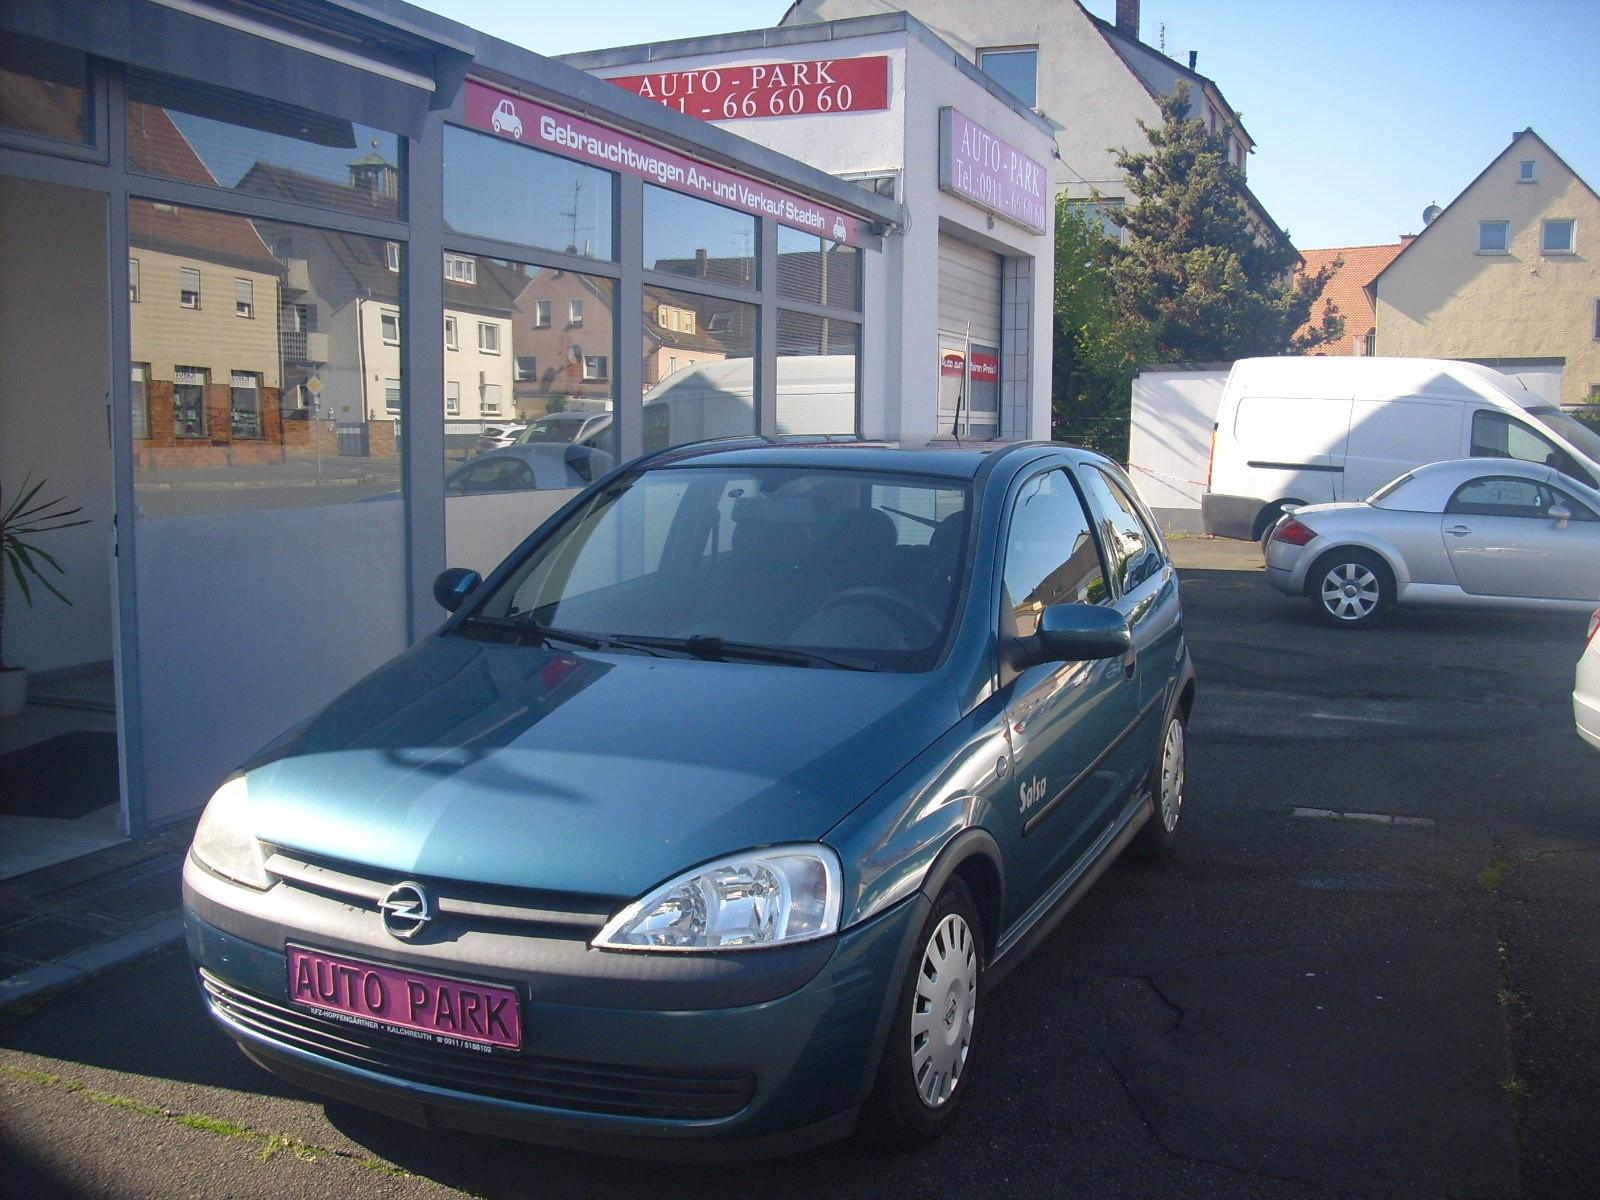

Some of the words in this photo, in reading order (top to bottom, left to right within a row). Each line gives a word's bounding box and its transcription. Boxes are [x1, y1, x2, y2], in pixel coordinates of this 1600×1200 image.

[639, 70, 721, 98] AUTO
[751, 61, 837, 89] PARK
[722, 92, 757, 118] 66
[769, 88, 804, 114] 60
[816, 84, 853, 111] 60
[540, 115, 685, 183] Gebrauchtwagen
[686, 166, 712, 191] An-
[712, 180, 737, 201] und
[738, 184, 785, 217] Verkauf
[785, 201, 825, 230] Stadeln
[961, 122, 1000, 172] AUTO
[1010, 152, 1040, 198] PARK
[1019, 774, 1047, 814] Salsa
[295, 954, 385, 1014] AUTO
[406, 979, 512, 1041] PARK
[386, 1025, 432, 1041] KALCHREUTH
